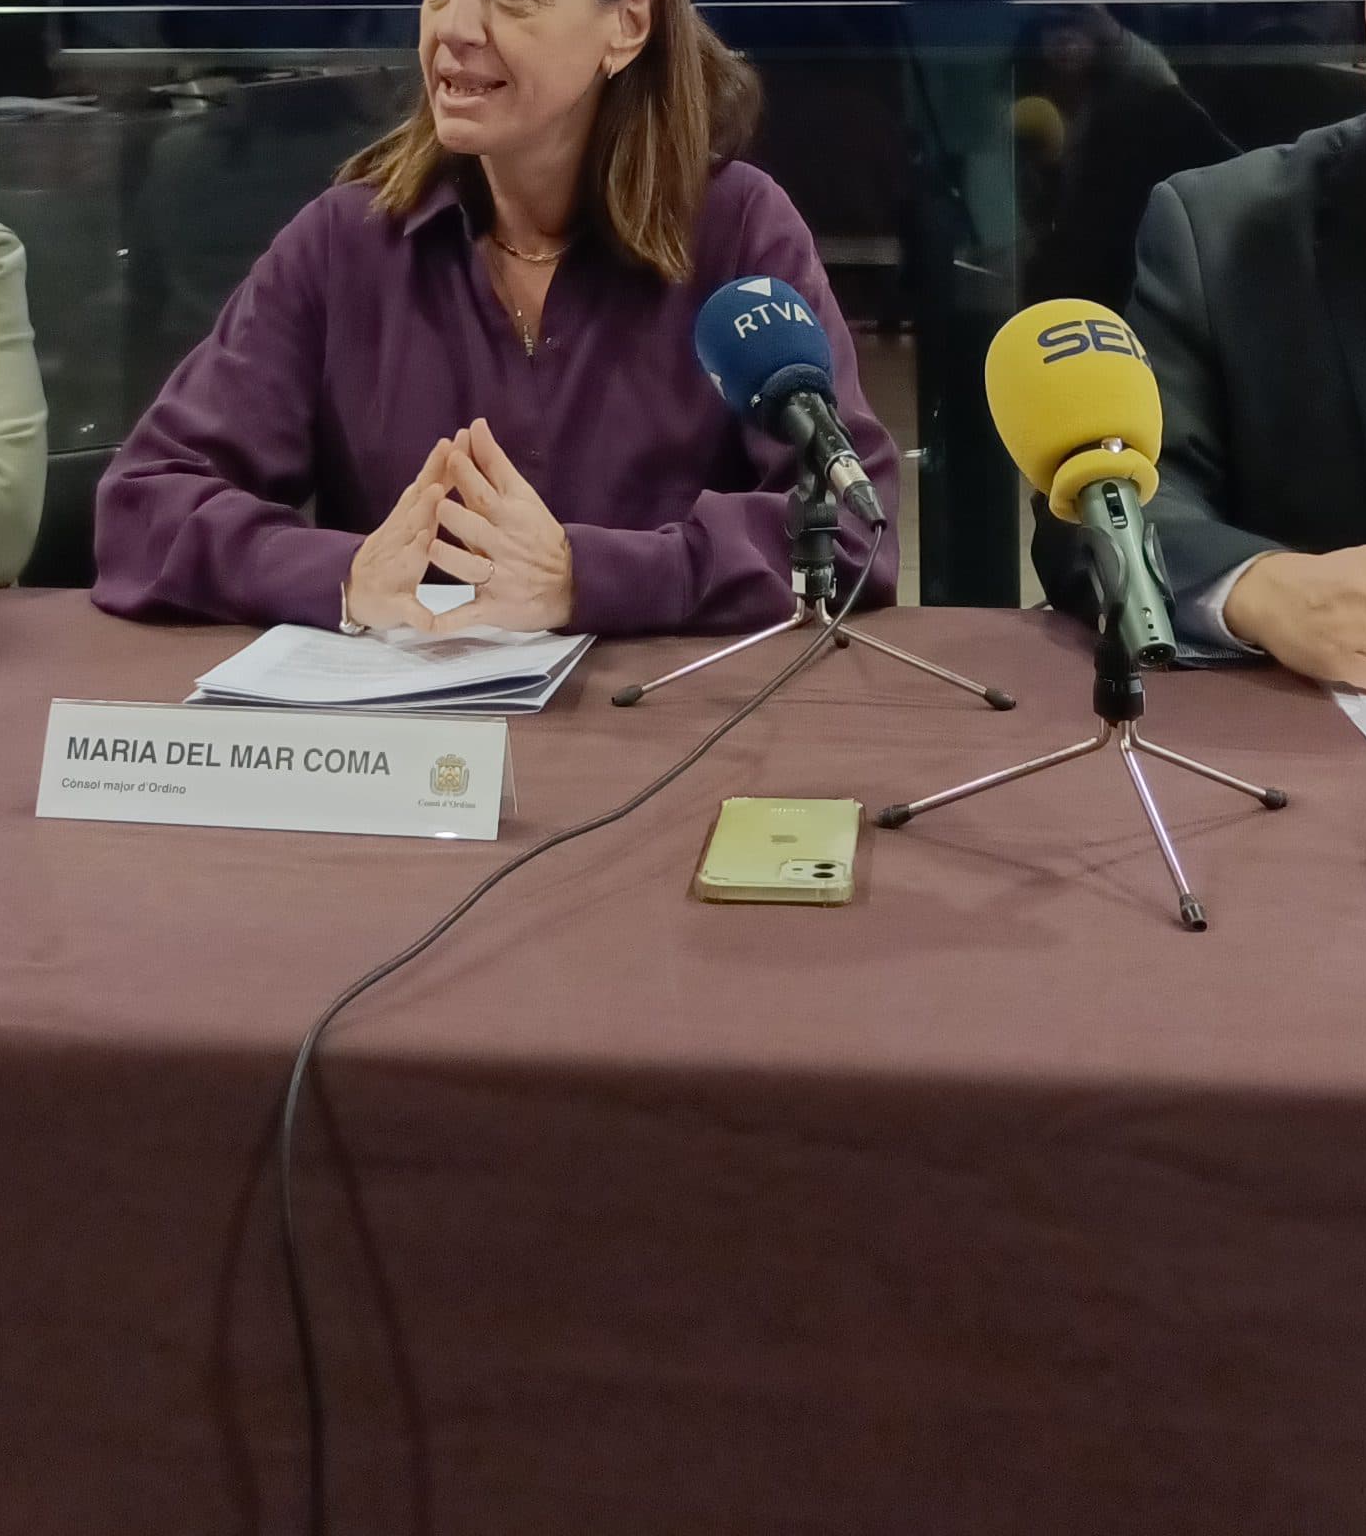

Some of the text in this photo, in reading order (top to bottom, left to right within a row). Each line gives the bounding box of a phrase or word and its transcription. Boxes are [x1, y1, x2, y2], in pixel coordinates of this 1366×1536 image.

[734, 301, 815, 339] RTVA
[66, 736, 391, 776] MARIA DEL MAR COMA
[103, 780, 135, 793] major
[137, 781, 187, 794] d'Ordino
